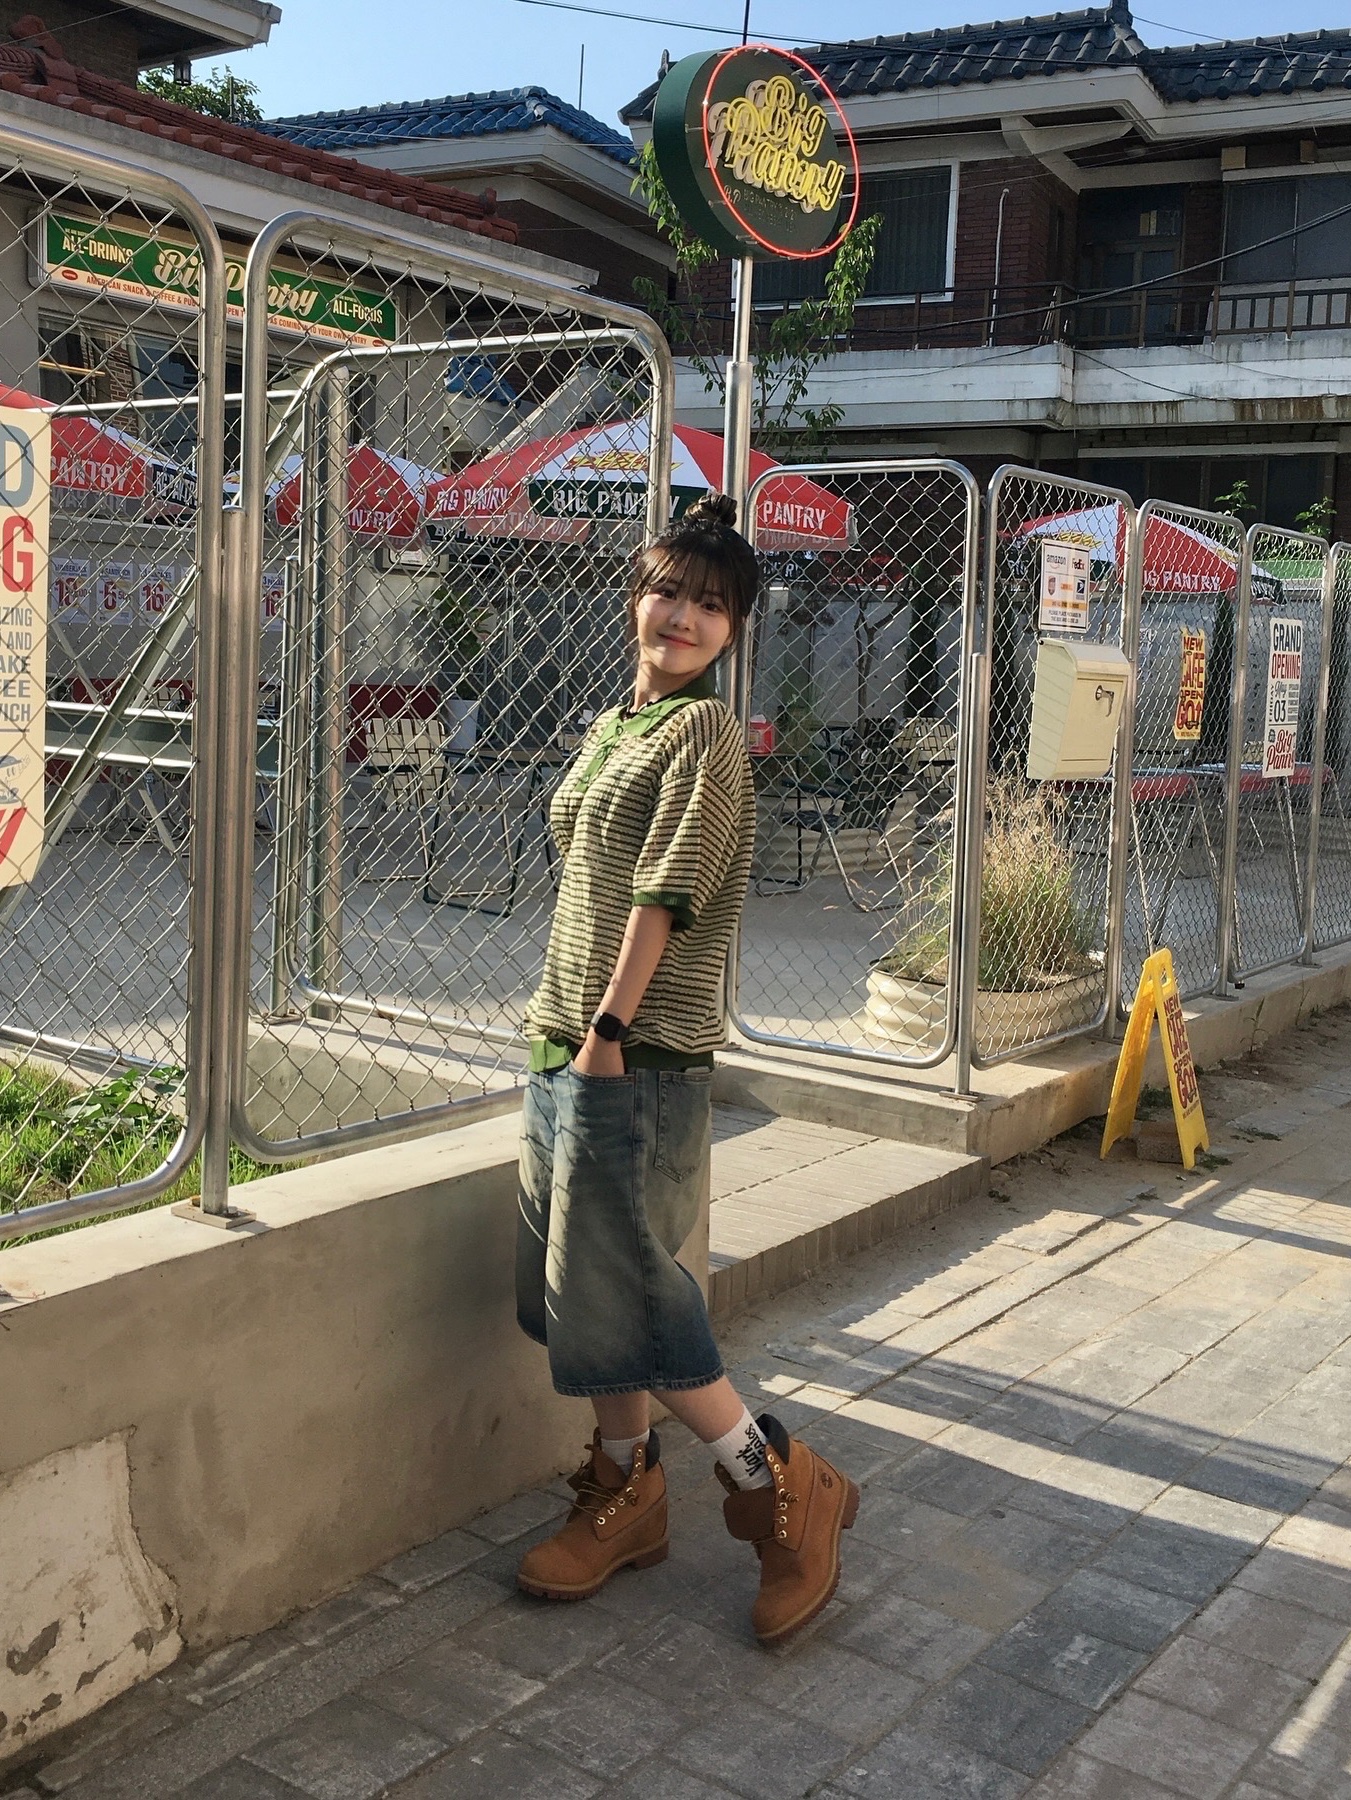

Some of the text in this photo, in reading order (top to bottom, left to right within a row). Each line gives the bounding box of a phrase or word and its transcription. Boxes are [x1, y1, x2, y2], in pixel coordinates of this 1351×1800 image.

[746, 75, 827, 157] Big
[706, 97, 846, 213] Pantry
[62, 234, 134, 264] ALL-DRINKS
[153, 249, 319, 317] Bi Pntry
[86, 275, 121, 290] AMERICAN
[122, 283, 145, 295] SNACK
[152, 290, 176, 302] COFFEE
[226, 306, 239, 317] PEN
[279, 319, 301, 331] COMING
[317, 327, 333, 338] YOUR
[332, 299, 383, 324] ALL-FOODS
[552, 489, 681, 519] BIG PANTY
[763, 500, 826, 531] PANTRY
[1047, 554, 1067, 566] amazon
[1143, 569, 1221, 591] IG PANTRY
[7, 631, 33, 651] AND
[1183, 636, 1203, 651] NEW
[1273, 623, 1301, 653] GRAND
[1271, 653, 1301, 680] OPENING
[0, 679, 31, 698] EE
[1180, 689, 1204, 700] OPEN
[1273, 699, 1287, 723] 03
[1276, 729, 1293, 754] Big
[1266, 744, 1296, 773] Pantry
[1163, 992, 1179, 1015] NEW
[1173, 1051, 1192, 1073] OPEN
